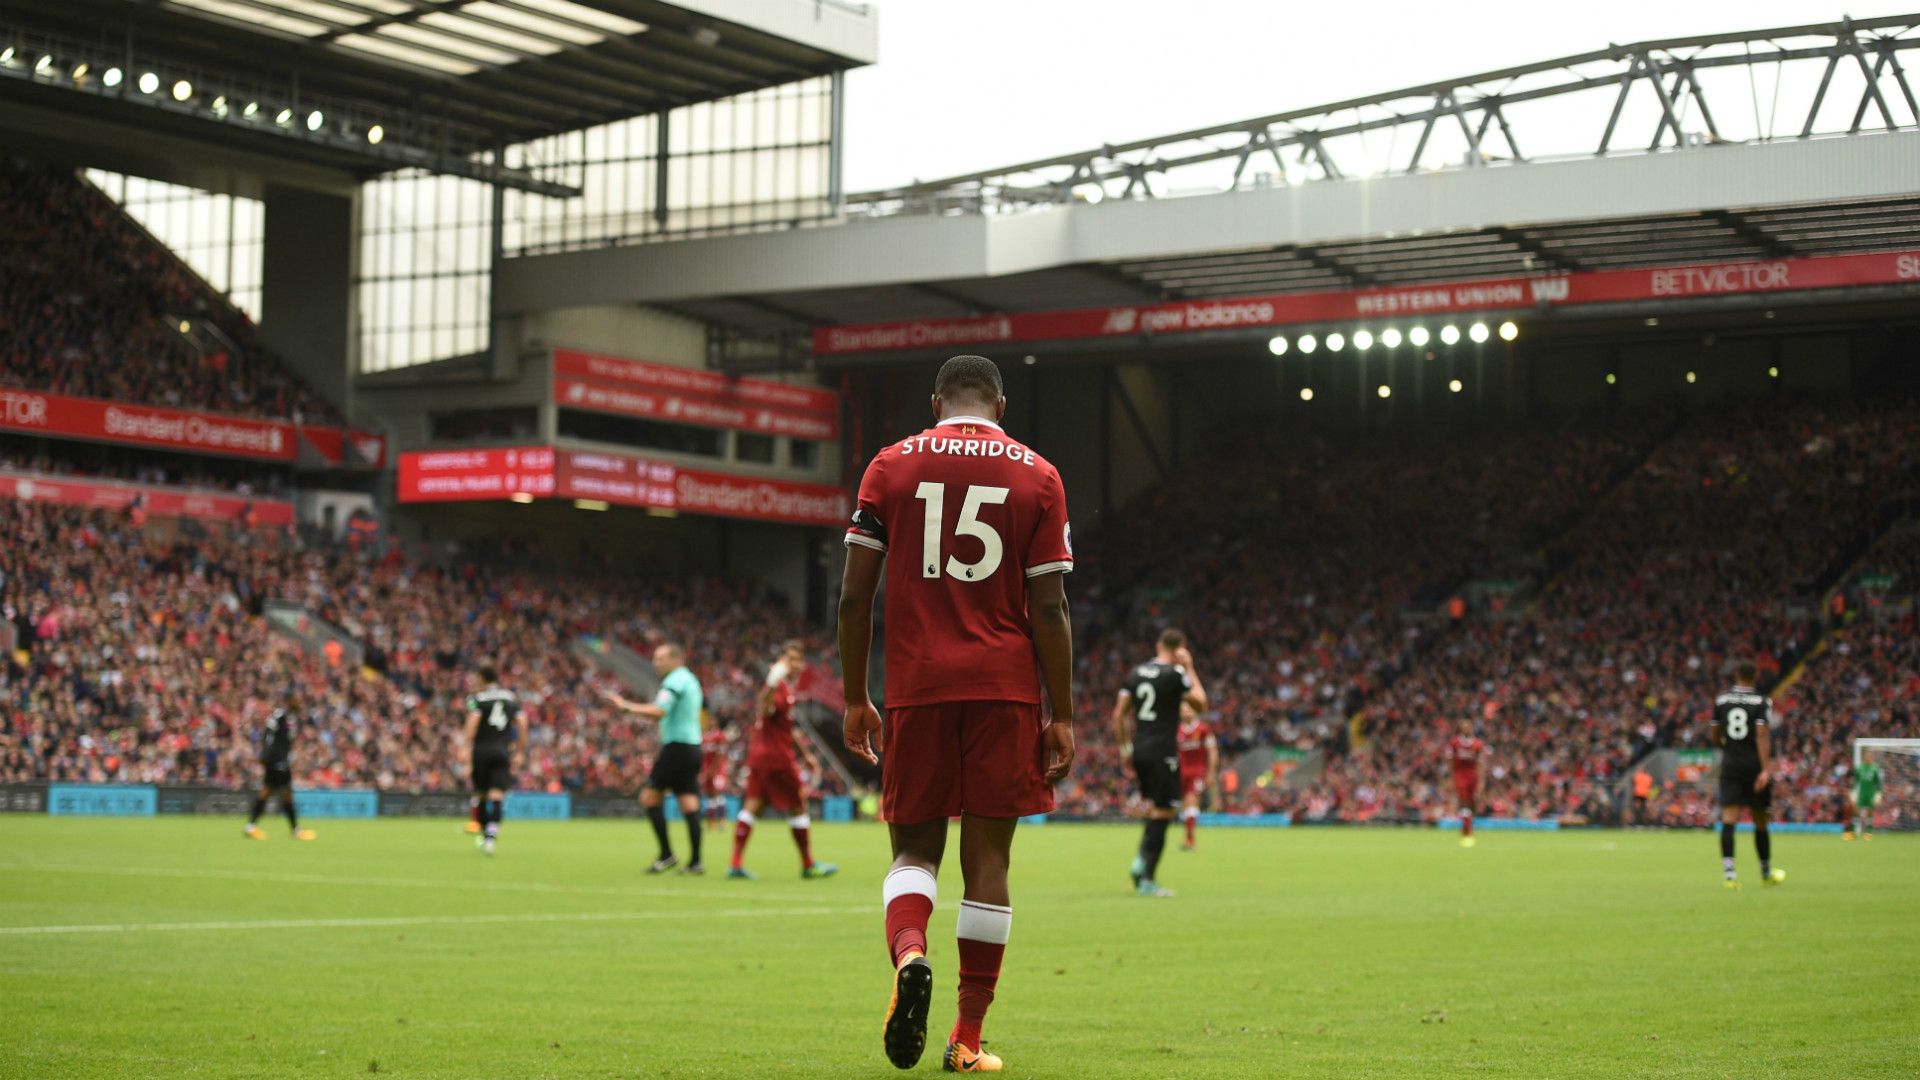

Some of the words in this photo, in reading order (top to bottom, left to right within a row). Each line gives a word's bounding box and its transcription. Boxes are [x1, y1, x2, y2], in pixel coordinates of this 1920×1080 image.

[1652, 262, 1790, 296] BETVICTOR
[1356, 288, 1450, 313] WESTERN
[1455, 284, 1523, 306] UNION
[1140, 311, 1184, 333] new
[1186, 302, 1275, 328] balance
[829, 326, 906, 350] Standard
[910, 320, 997, 345] Chartered
[0, 392, 48, 424] TOR
[105, 406, 184, 441] Standard
[187, 416, 267, 450] Chartered
[901, 436, 1035, 466] STURRIDGE
[676, 474, 755, 512] Standard
[757, 484, 835, 519] Chartered
[915, 481, 1010, 582] 15
[488, 700, 508, 731] 4
[1136, 682, 1157, 721] 2
[1727, 707, 1749, 740] 8
